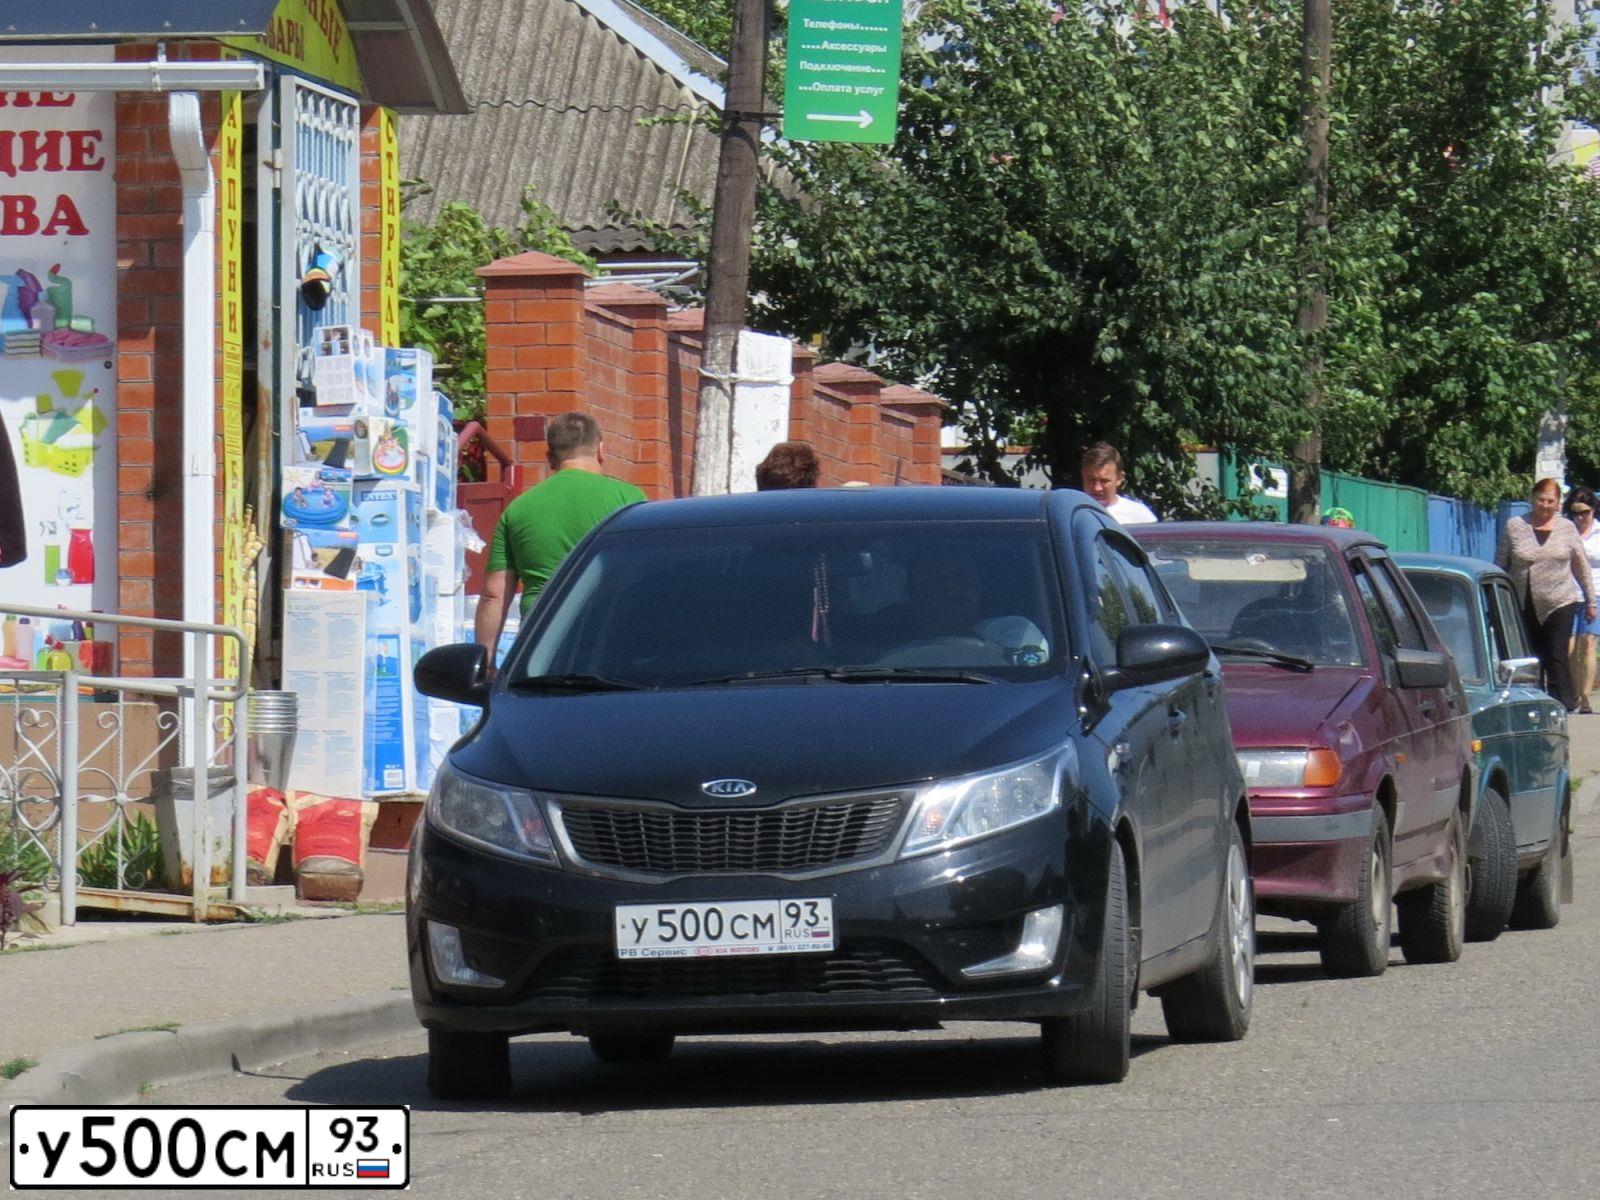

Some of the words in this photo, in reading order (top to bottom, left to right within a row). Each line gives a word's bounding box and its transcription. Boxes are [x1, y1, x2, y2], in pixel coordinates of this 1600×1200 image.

[854, 85, 885, 96] услуг
[224, 53, 238, 333] АМПУНИ
[711, 782, 747, 793] KIA
[785, 901, 819, 928] 93
[785, 928, 810, 938] RUS
[640, 948, 687, 958] Сервис
